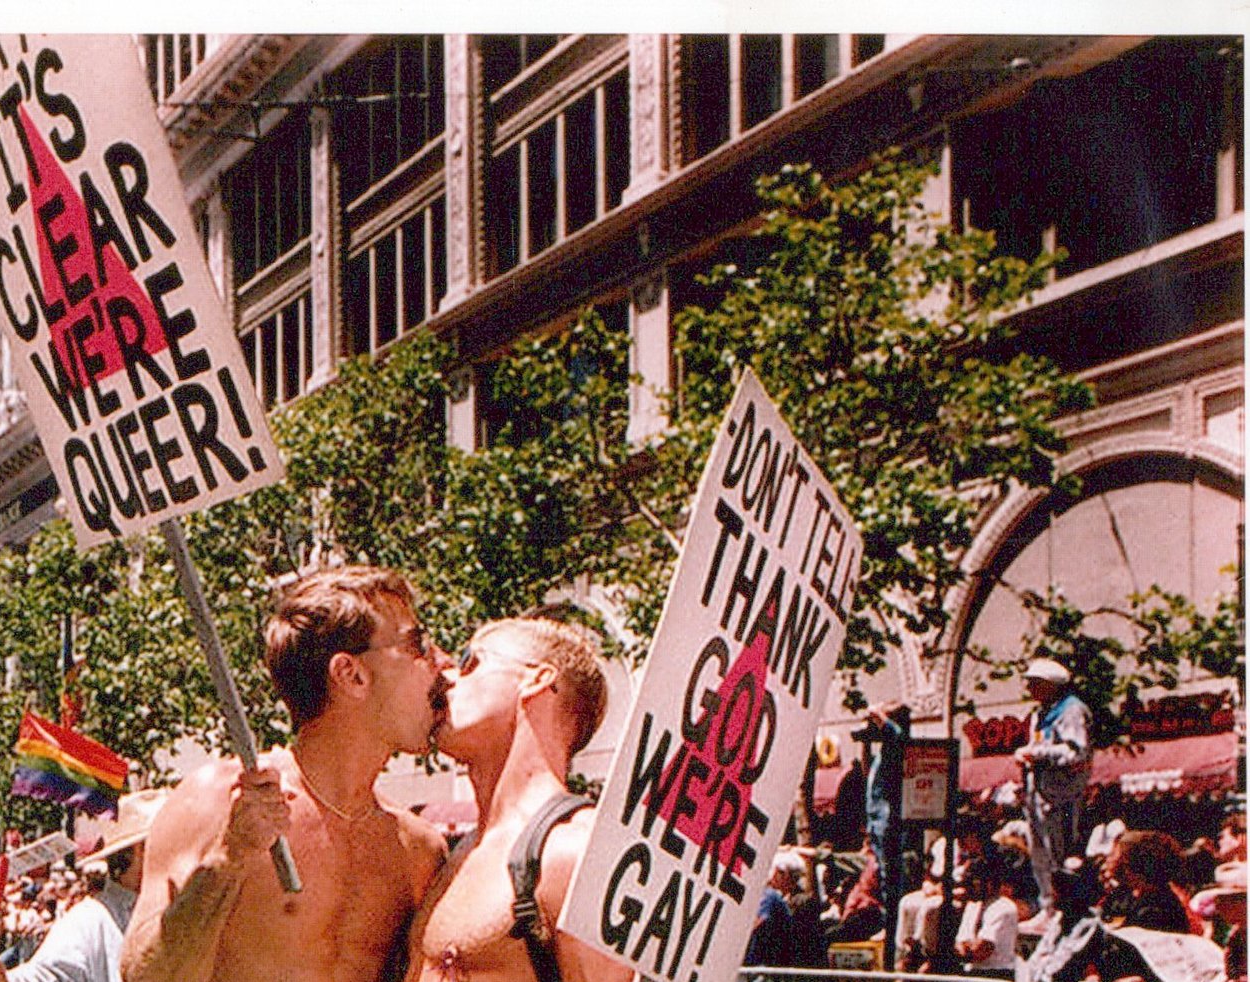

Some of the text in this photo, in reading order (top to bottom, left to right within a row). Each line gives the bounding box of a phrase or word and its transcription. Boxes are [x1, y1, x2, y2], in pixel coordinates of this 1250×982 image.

[30, 262, 211, 432] WE'RE
[63, 366, 268, 537] QUEER!
[702, 497, 830, 709] THANK
[680, 635, 777, 786] GOD
[621, 712, 769, 906] WE'RE
